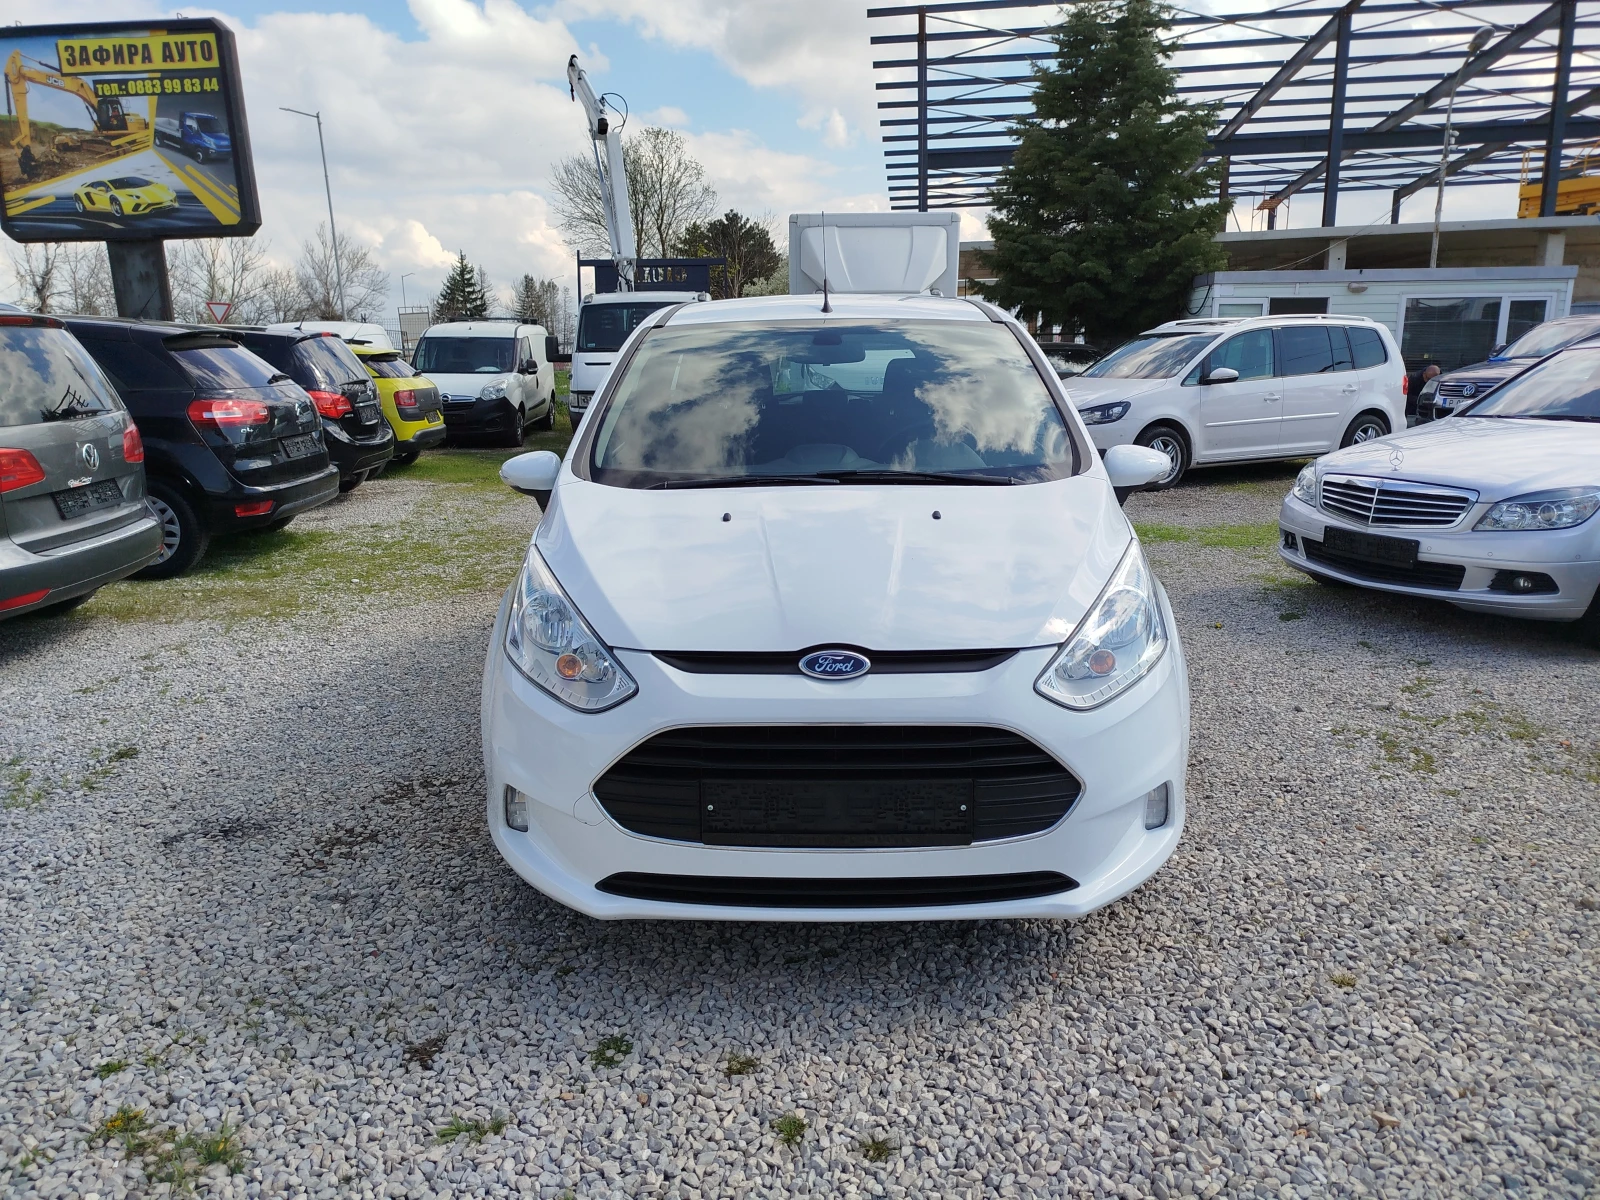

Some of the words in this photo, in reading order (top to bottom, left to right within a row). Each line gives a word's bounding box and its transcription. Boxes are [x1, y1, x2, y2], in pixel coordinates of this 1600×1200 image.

[64, 42, 153, 67] ЗАФИРА
[162, 40, 213, 63] АУТО
[96, 82, 126, 96] тел.:
[127, 79, 161, 95] 0883
[164, 78, 181, 94] 99
[184, 78, 201, 93] 83
[203, 77, 219, 92] 44
[815, 655, 854, 673] Ford
